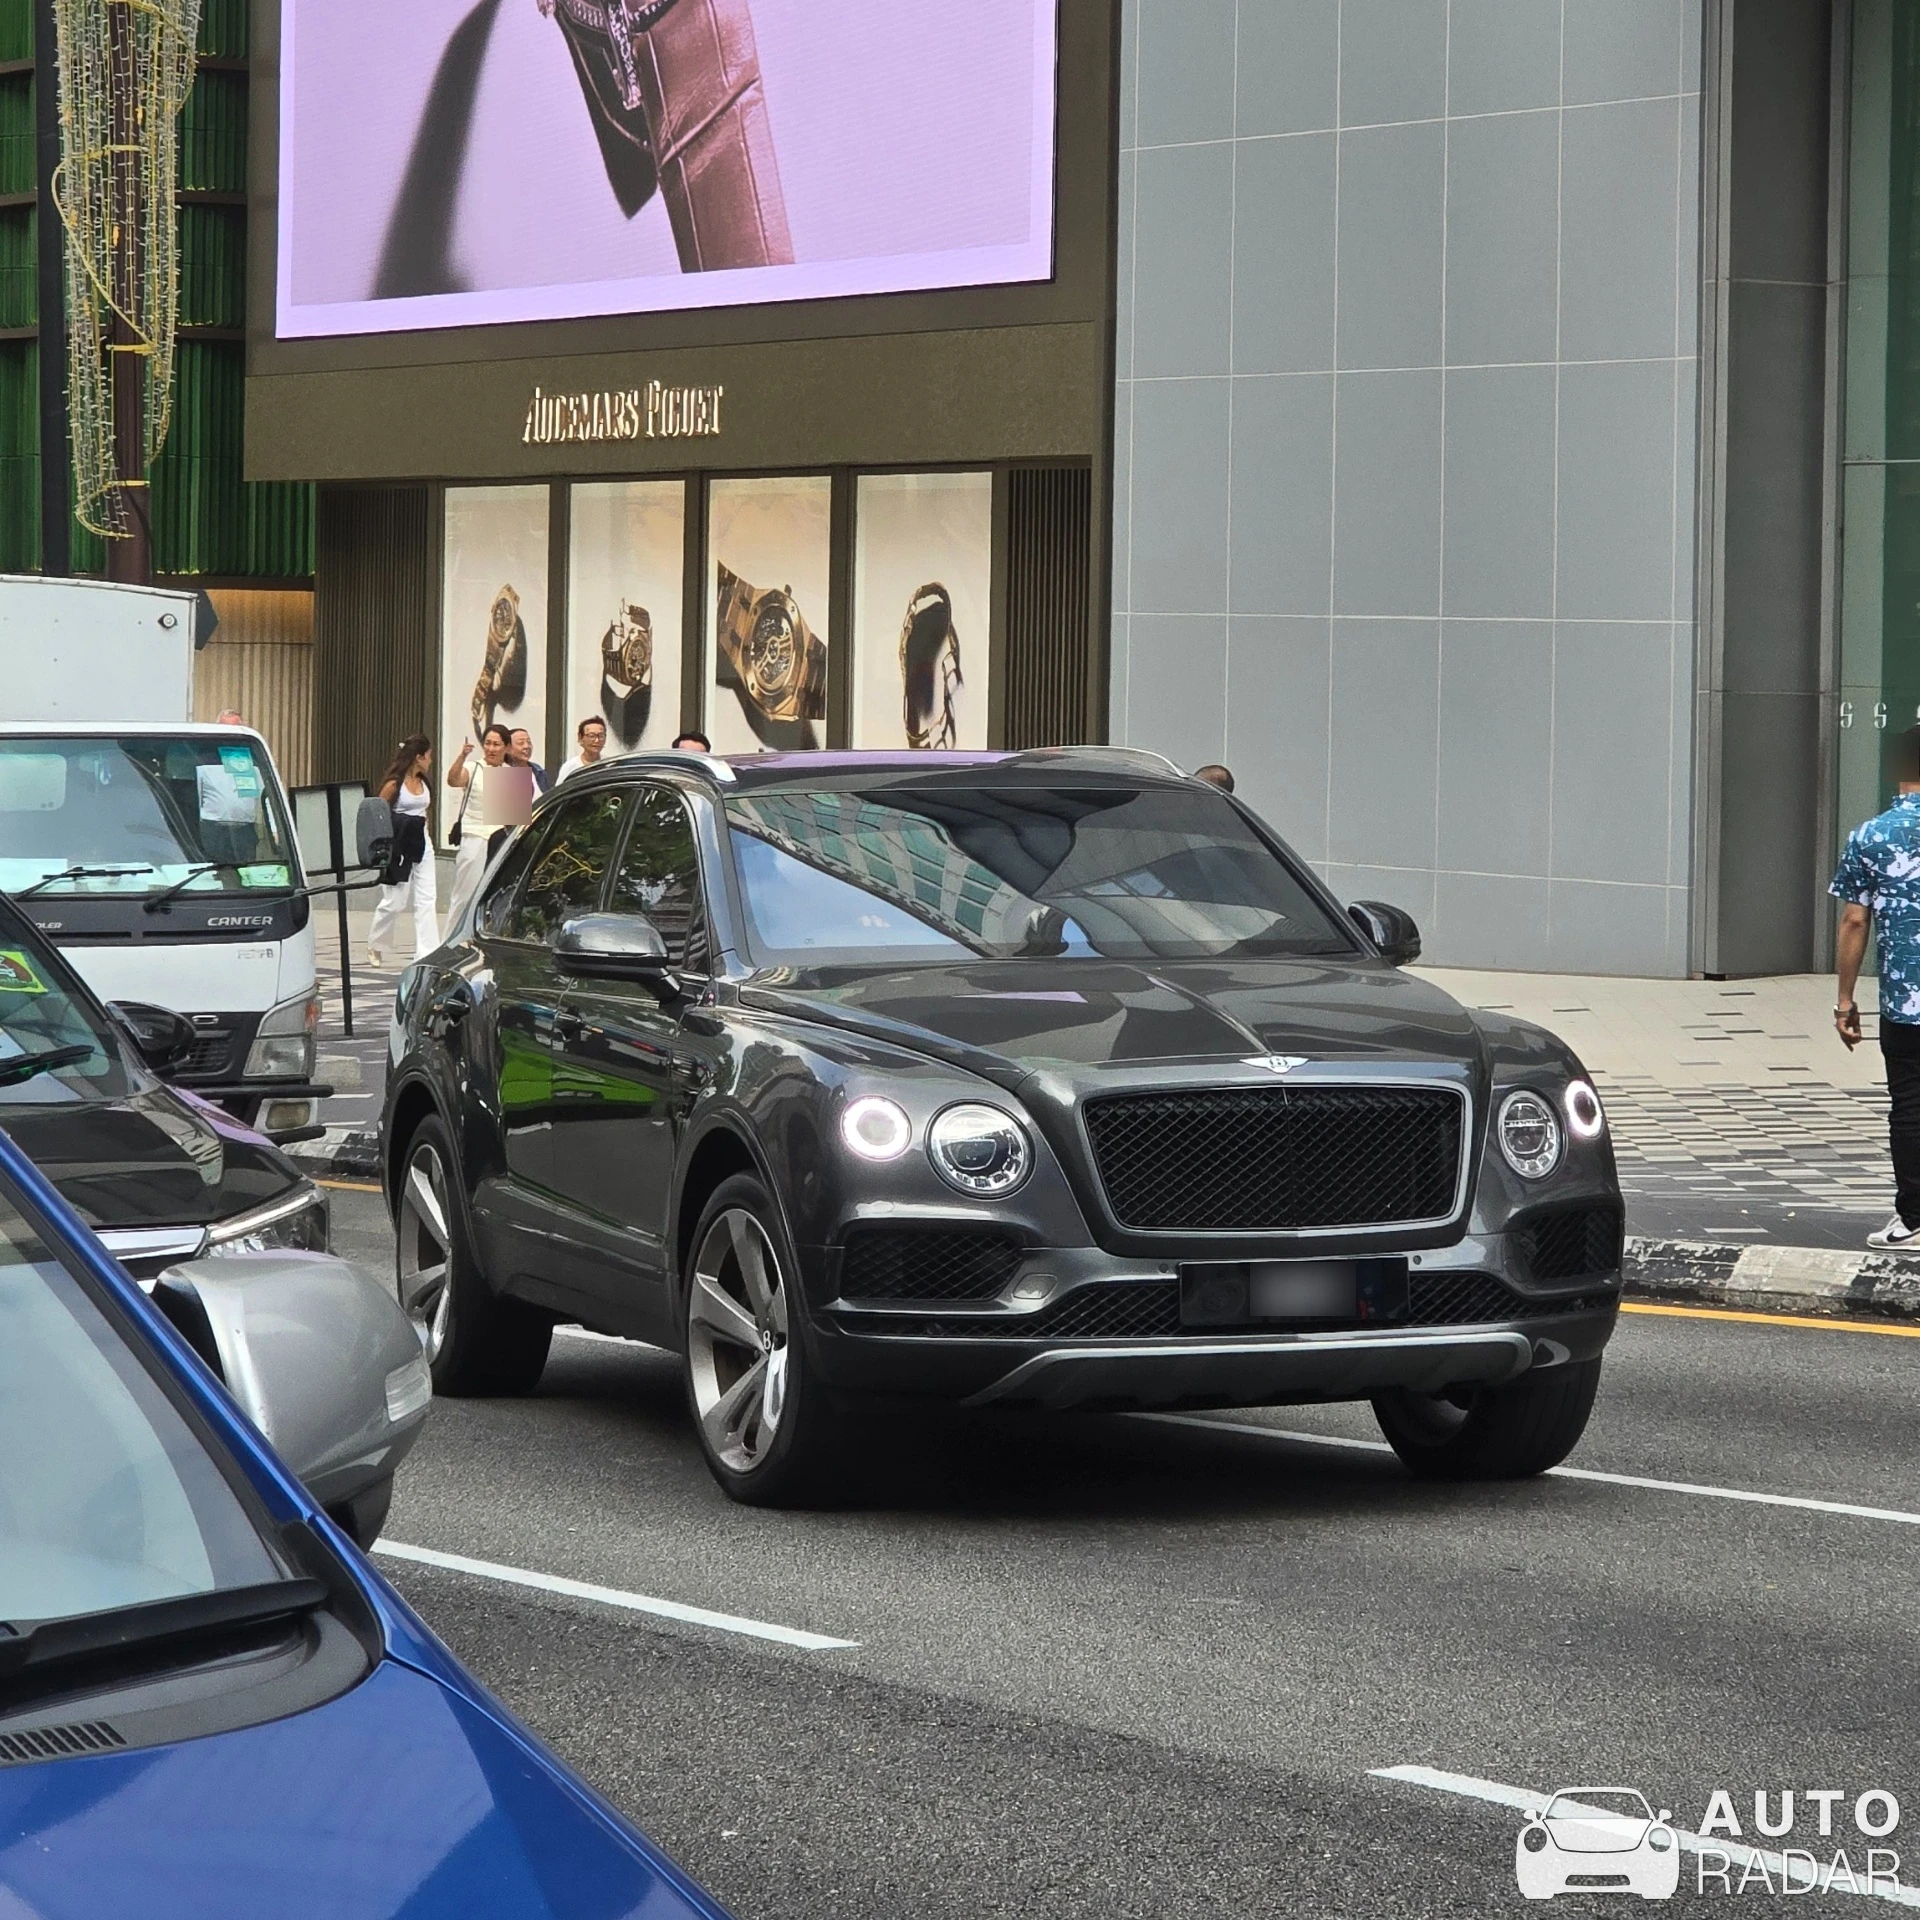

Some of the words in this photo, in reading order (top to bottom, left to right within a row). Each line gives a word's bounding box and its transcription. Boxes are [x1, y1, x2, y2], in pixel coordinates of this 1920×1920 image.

[522, 386, 639, 443] AUDEMARS
[644, 379, 723, 437] PIGUET
[207, 915, 274, 927] CANTER
